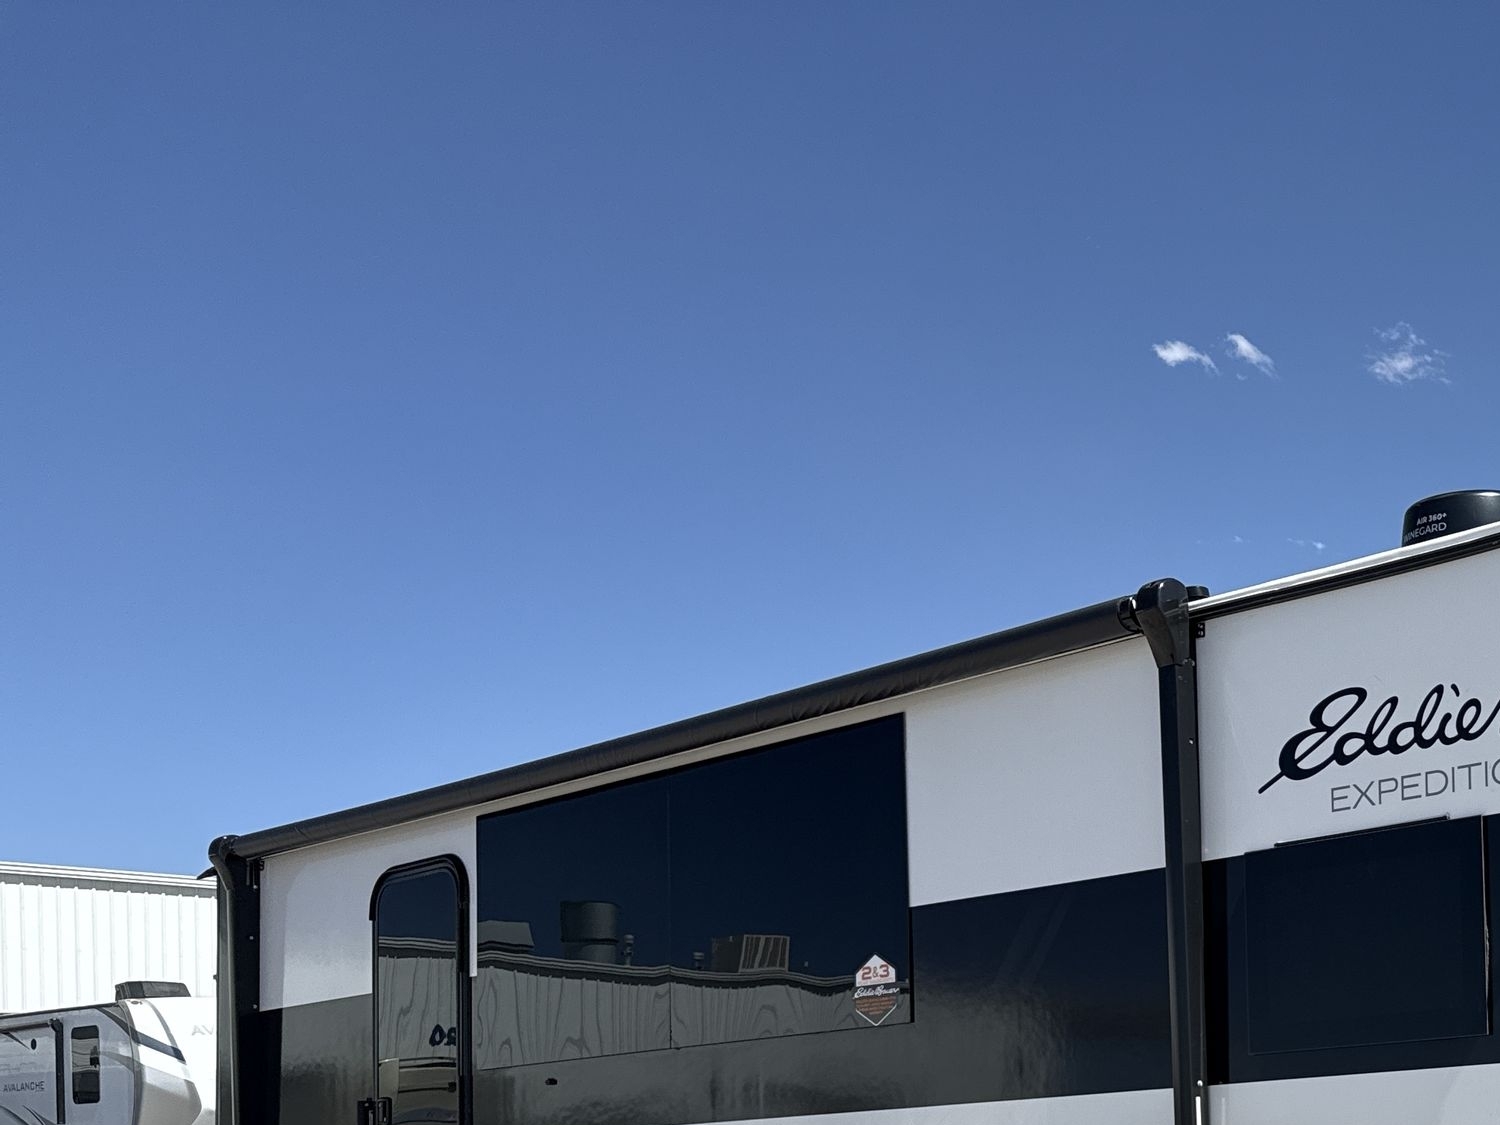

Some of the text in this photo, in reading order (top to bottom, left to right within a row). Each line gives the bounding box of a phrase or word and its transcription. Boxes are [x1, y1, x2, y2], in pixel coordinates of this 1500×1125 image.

[1416, 515, 1428, 526] AIR
[1258, 683, 1496, 794] Eddie
[3, 1080, 45, 1093] AVALANCHE
